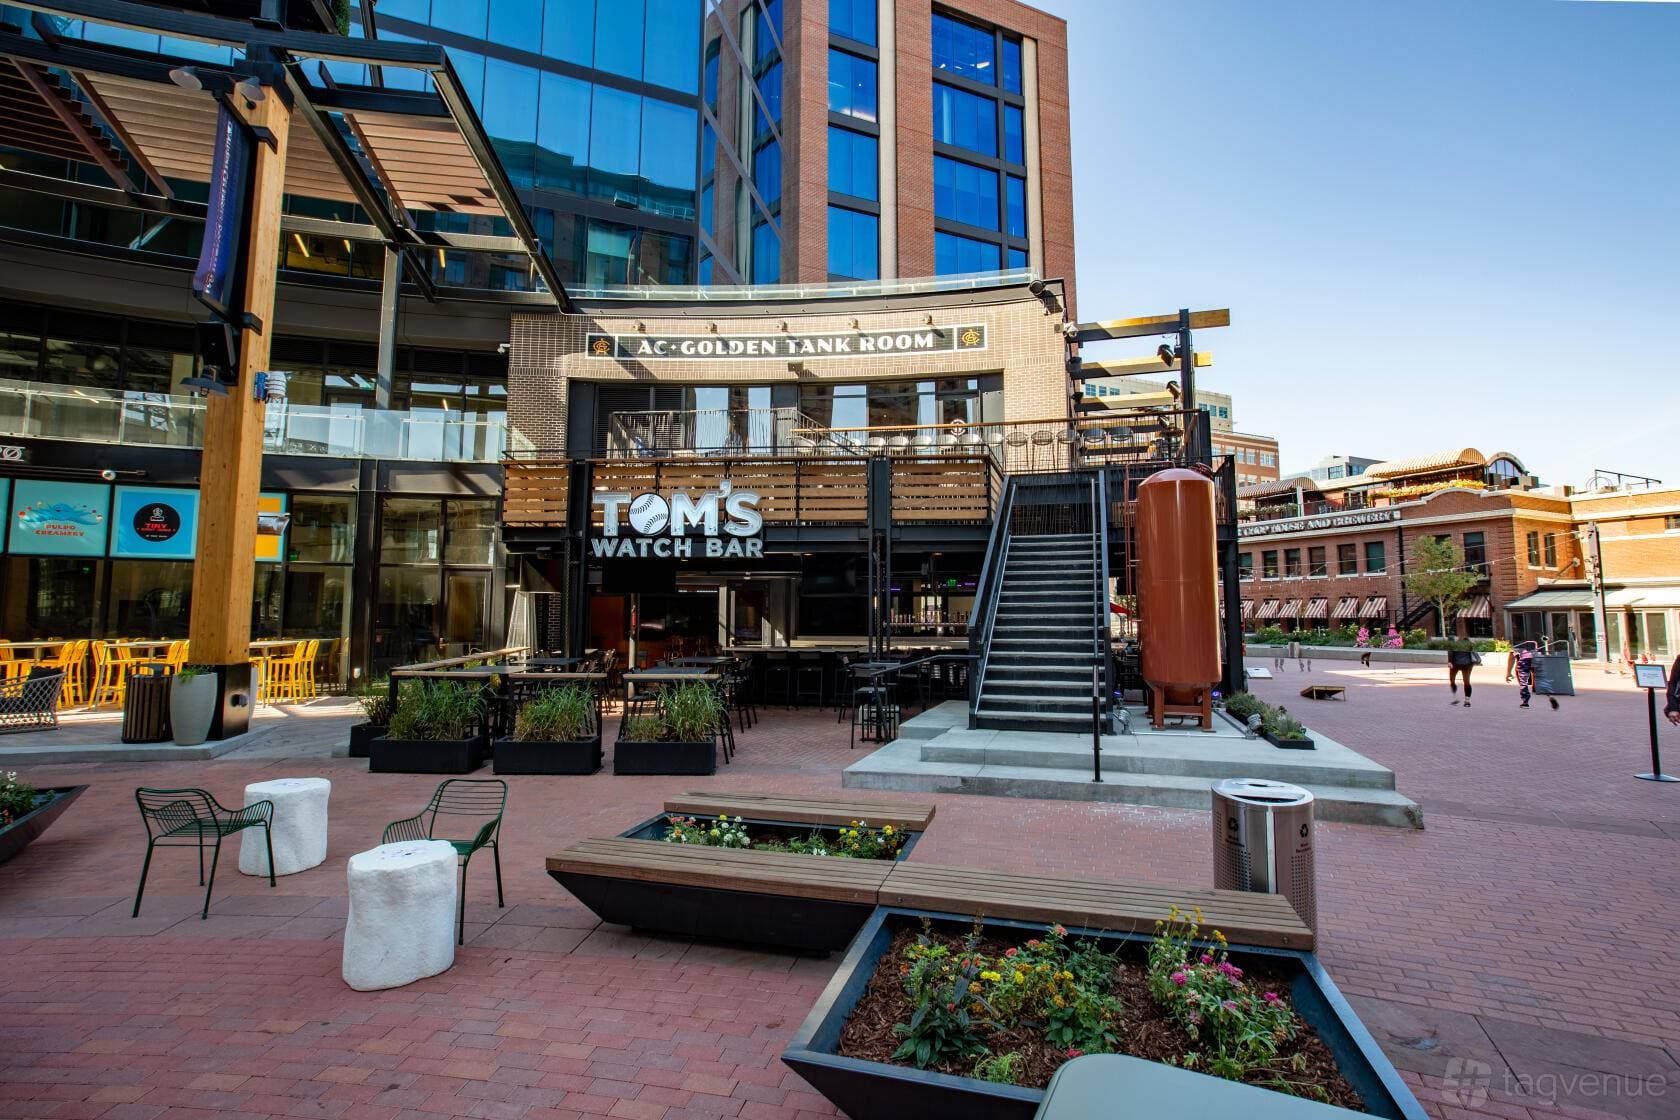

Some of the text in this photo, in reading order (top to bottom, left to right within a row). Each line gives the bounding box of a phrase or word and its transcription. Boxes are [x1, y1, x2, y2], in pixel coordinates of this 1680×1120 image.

[680, 339, 776, 355] GOLDEN
[786, 337, 851, 354] TANK
[860, 333, 934, 352] ROOM
[592, 479, 763, 537] TOM'S
[591, 537, 764, 559] WATCH BAR
